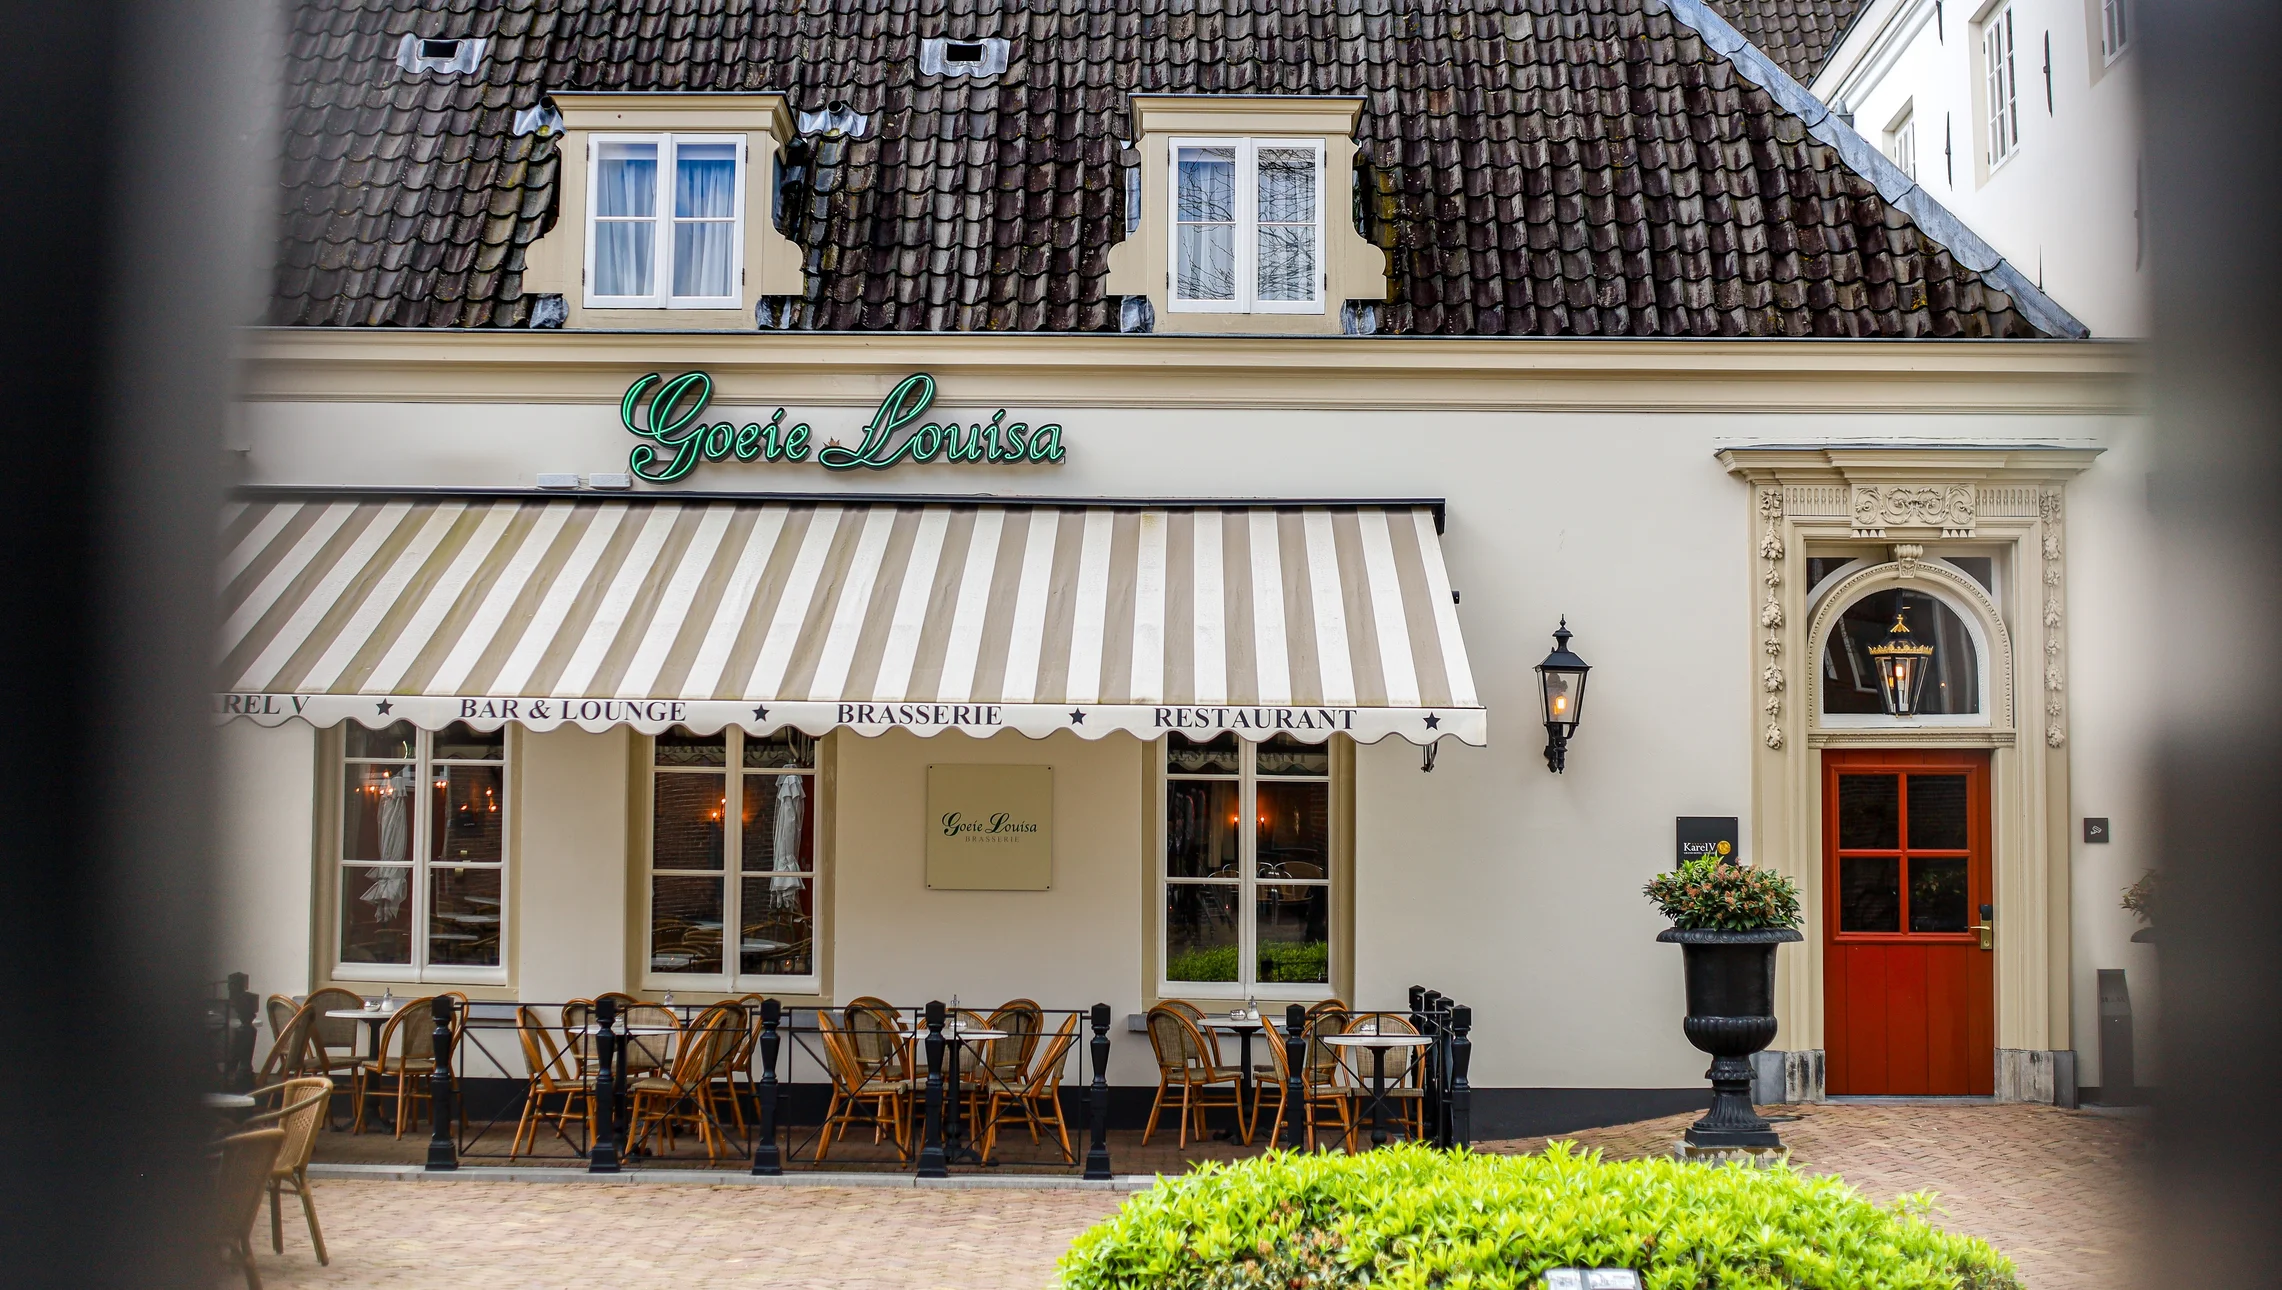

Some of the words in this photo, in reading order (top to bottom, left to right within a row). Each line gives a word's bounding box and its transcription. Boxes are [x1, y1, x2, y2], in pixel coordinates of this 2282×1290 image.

[621, 370, 813, 484] Goeie
[818, 372, 1066, 472] Louisa
[212, 694, 281, 715] REL
[291, 695, 311, 715] V
[459, 698, 520, 719] BAR
[528, 699, 551, 720] &
[560, 700, 687, 722] LOUNGE
[836, 703, 1003, 725] BRASSERIE
[1153, 707, 1358, 730] RESTAURANT
[941, 811, 983, 837] Goeie
[984, 811, 1038, 834] Louisa
